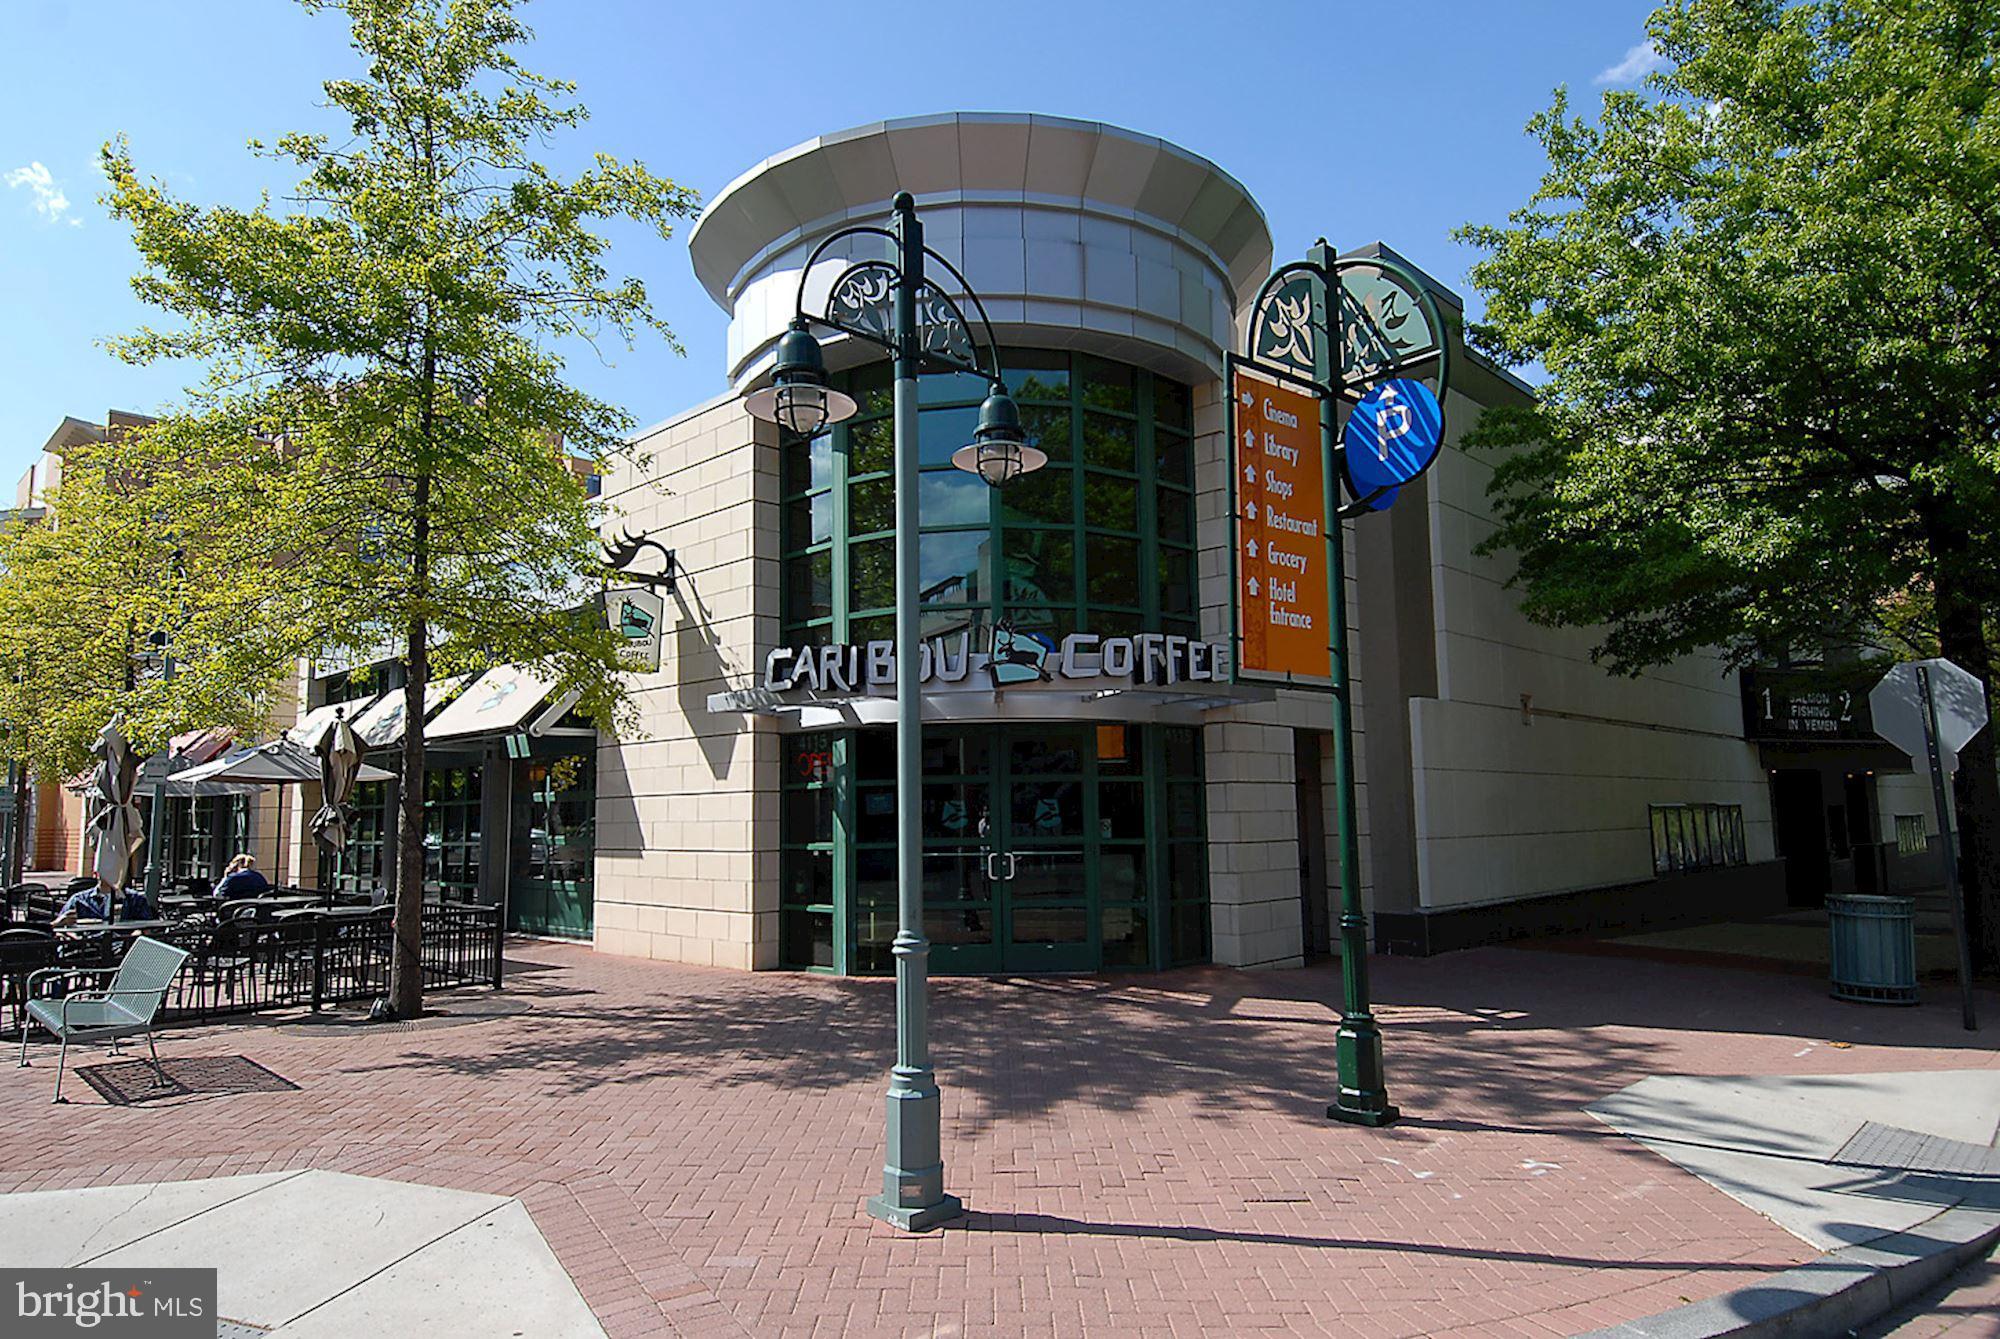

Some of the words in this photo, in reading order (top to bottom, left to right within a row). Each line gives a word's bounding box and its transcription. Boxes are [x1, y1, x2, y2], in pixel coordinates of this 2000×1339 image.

[1263, 398, 1298, 429] Cinema
[1375, 404, 1413, 462] P
[1263, 432, 1299, 468] Library
[1265, 469, 1294, 500] Shops
[1266, 504, 1318, 537] Restaurant
[1267, 541, 1307, 575] Grocery
[1269, 576, 1297, 603] Hotel
[1270, 601, 1312, 629] Entrance
[1061, 633, 1229, 685] COFFEE
[1761, 687, 1774, 720] 1
[1790, 704, 1831, 718] FISHING
[1838, 689, 1853, 722] 2
[1787, 718, 1800, 731] IN
[1805, 718, 1838, 732] YEMEN
